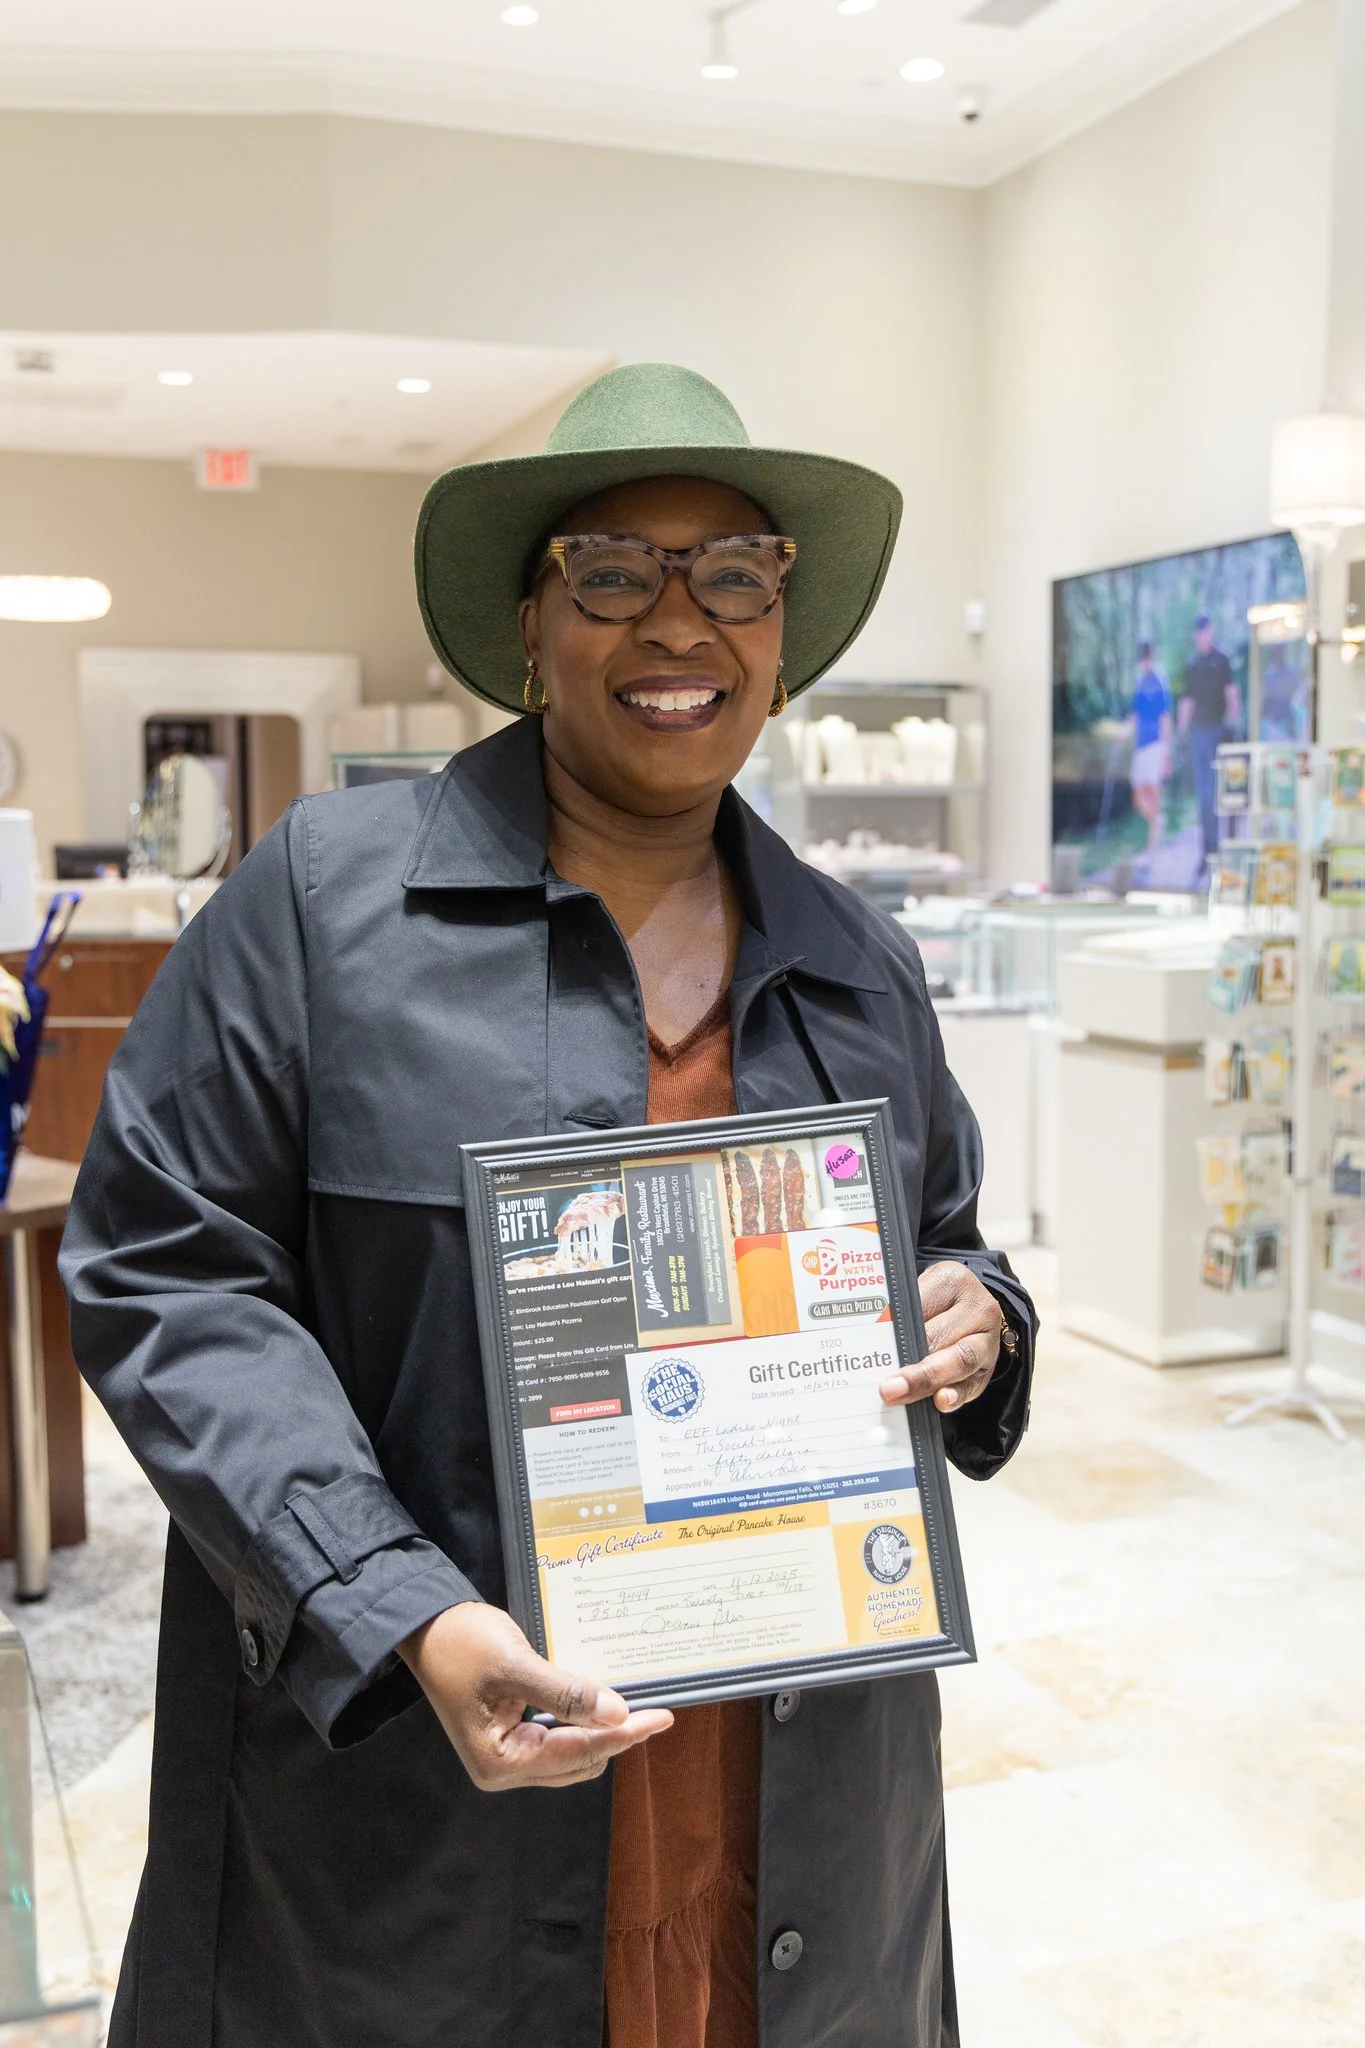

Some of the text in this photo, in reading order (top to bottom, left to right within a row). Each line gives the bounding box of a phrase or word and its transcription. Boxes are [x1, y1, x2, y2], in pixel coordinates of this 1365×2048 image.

[522, 1196, 545, 1210] YOUR
[653, 1193, 662, 1212] Capitol
[497, 1210, 549, 1243] GIFT!
[634, 1181, 668, 1317] Maxim's Family Restaurant
[841, 1251, 882, 1264] Pizza
[843, 1265, 874, 1275] WITH
[527, 1283, 555, 1292] received
[575, 1277, 605, 1286] Malnati's
[820, 1274, 885, 1292] Purpose
[515, 1305, 541, 1314] Elmbrook
[542, 1302, 569, 1311] Education
[570, 1298, 599, 1307] Foundation
[612, 1295, 627, 1303] Open
[680, 1285, 690, 1311] SUNDAYS
[536, 1319, 560, 1327] Malnati's
[534, 1336, 554, 1344] $25.00
[818, 1338, 842, 1349] 3120
[514, 1354, 536, 1363] essage:
[556, 1350, 572, 1358] Enjoy
[514, 1362, 536, 1370] alnati's
[748, 1349, 892, 1383] Gift Certificate
[653, 1365, 680, 1384] THE
[648, 1373, 696, 1401] SOCIAL
[657, 1384, 693, 1407] HAUS
[751, 1391, 768, 1399] Date
[555, 1409, 571, 1417] FIND
[583, 1403, 615, 1413] LOCATION
[588, 1425, 617, 1433] REDEEM:
[683, 1426, 711, 1439] EEF
[715, 1420, 755, 1435] Ladies
[658, 1434, 669, 1442] To:
[660, 1450, 683, 1458] From:
[663, 1464, 694, 1475] Amount:
[665, 1480, 701, 1492] Approved
[726, 1494, 745, 1502] Lisbon
[762, 1487, 797, 1497] Menomonee
[798, 1485, 812, 1493] Falls,
[863, 1497, 896, 1510] #3670
[677, 1510, 805, 1539] The Original Pancake House
[867, 1533, 877, 1545] THE
[575, 1540, 603, 1568] Gift
[604, 1529, 665, 1553] Certificate
[872, 1566, 908, 1583] PANCAKE HOUSE
[867, 1587, 920, 1601] AUTHENTIC
[869, 1598, 924, 1612] HOMEMADE
[873, 1604, 921, 1631] Goodness!
